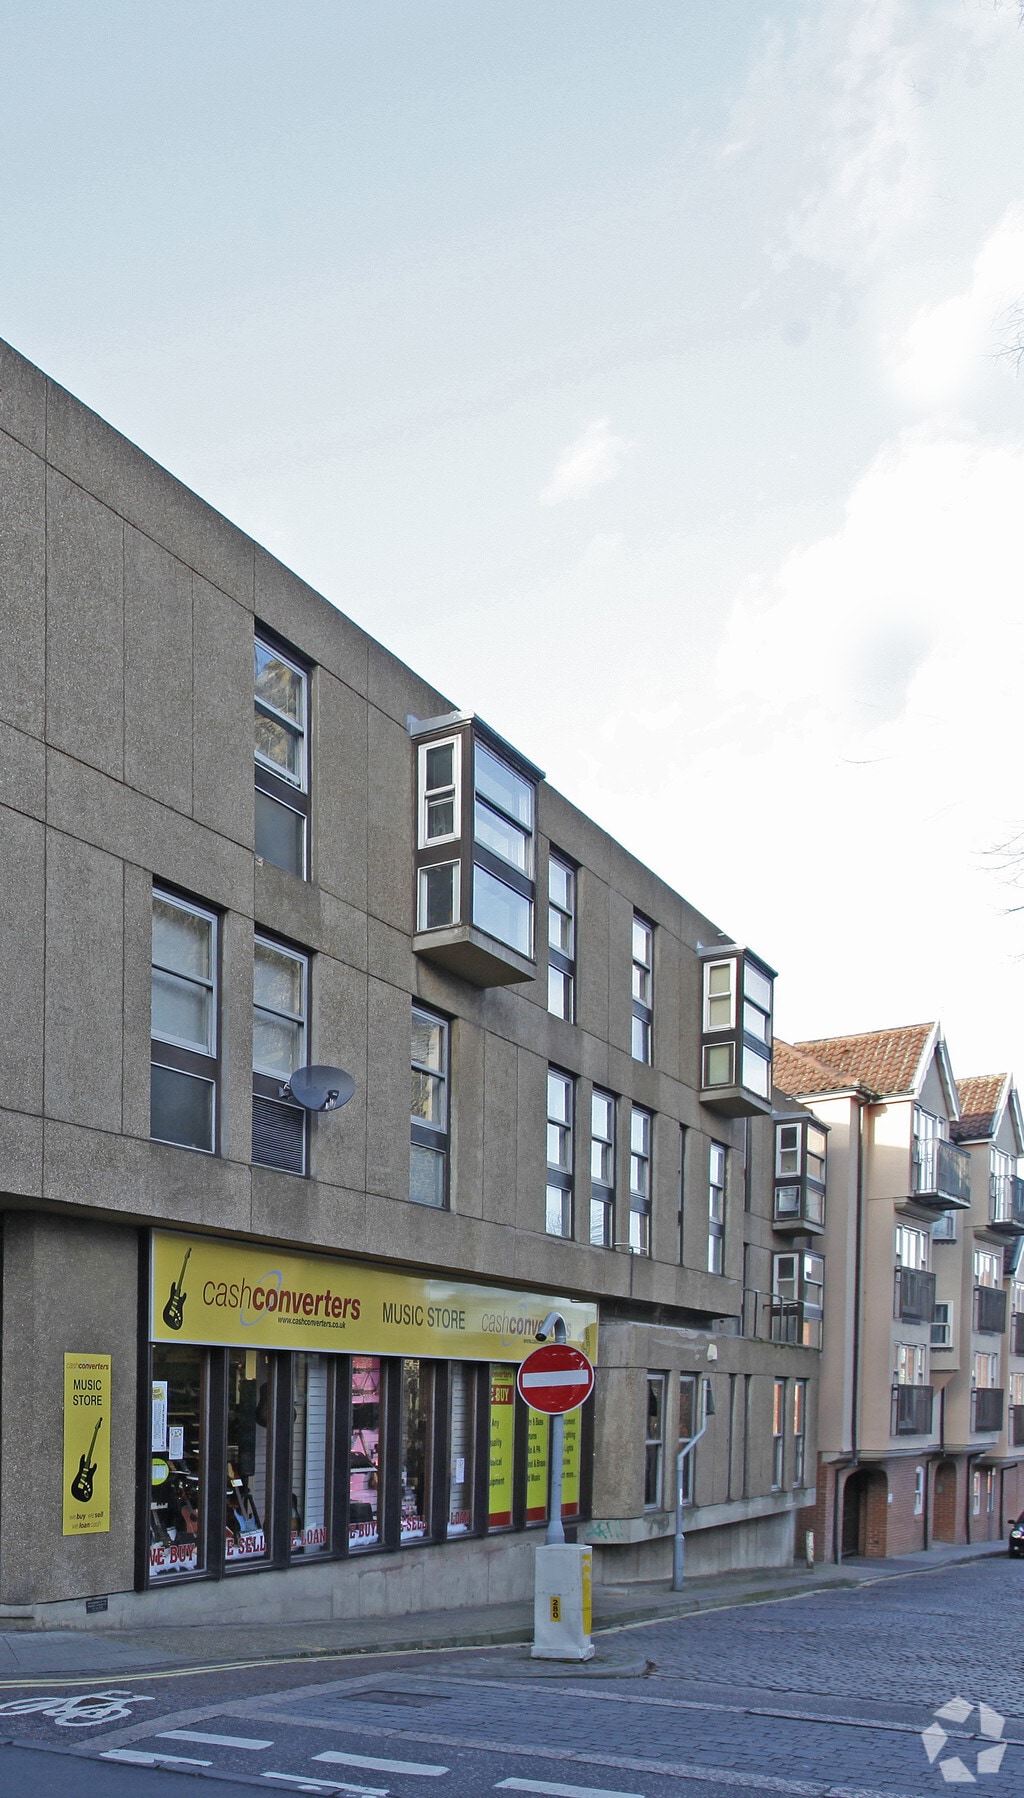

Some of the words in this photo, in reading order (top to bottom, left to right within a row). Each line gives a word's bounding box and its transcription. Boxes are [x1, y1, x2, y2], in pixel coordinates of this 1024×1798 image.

[203, 1277, 361, 1321] cashconverters
[277, 1315, 346, 1329] www.cashconverters.co.uk
[382, 1302, 424, 1327] MUSIC
[427, 1306, 466, 1330] STORE
[66, 1361, 109, 1371] cashconverters
[73, 1379, 102, 1391] MUSIC
[72, 1394, 103, 1406] STORE
[495, 1388, 510, 1402] BUY
[491, 1438, 502, 1449] uality
[490, 1456, 503, 1467] usical
[76, 1512, 86, 1520] buy
[290, 1530, 297, 1546] E
[300, 1527, 327, 1546] LOAN
[349, 1523, 356, 1539] E
[358, 1521, 377, 1537] BUY
[226, 1539, 234, 1556] E
[238, 1535, 267, 1553] SELL
[169, 1543, 196, 1563] BUY
